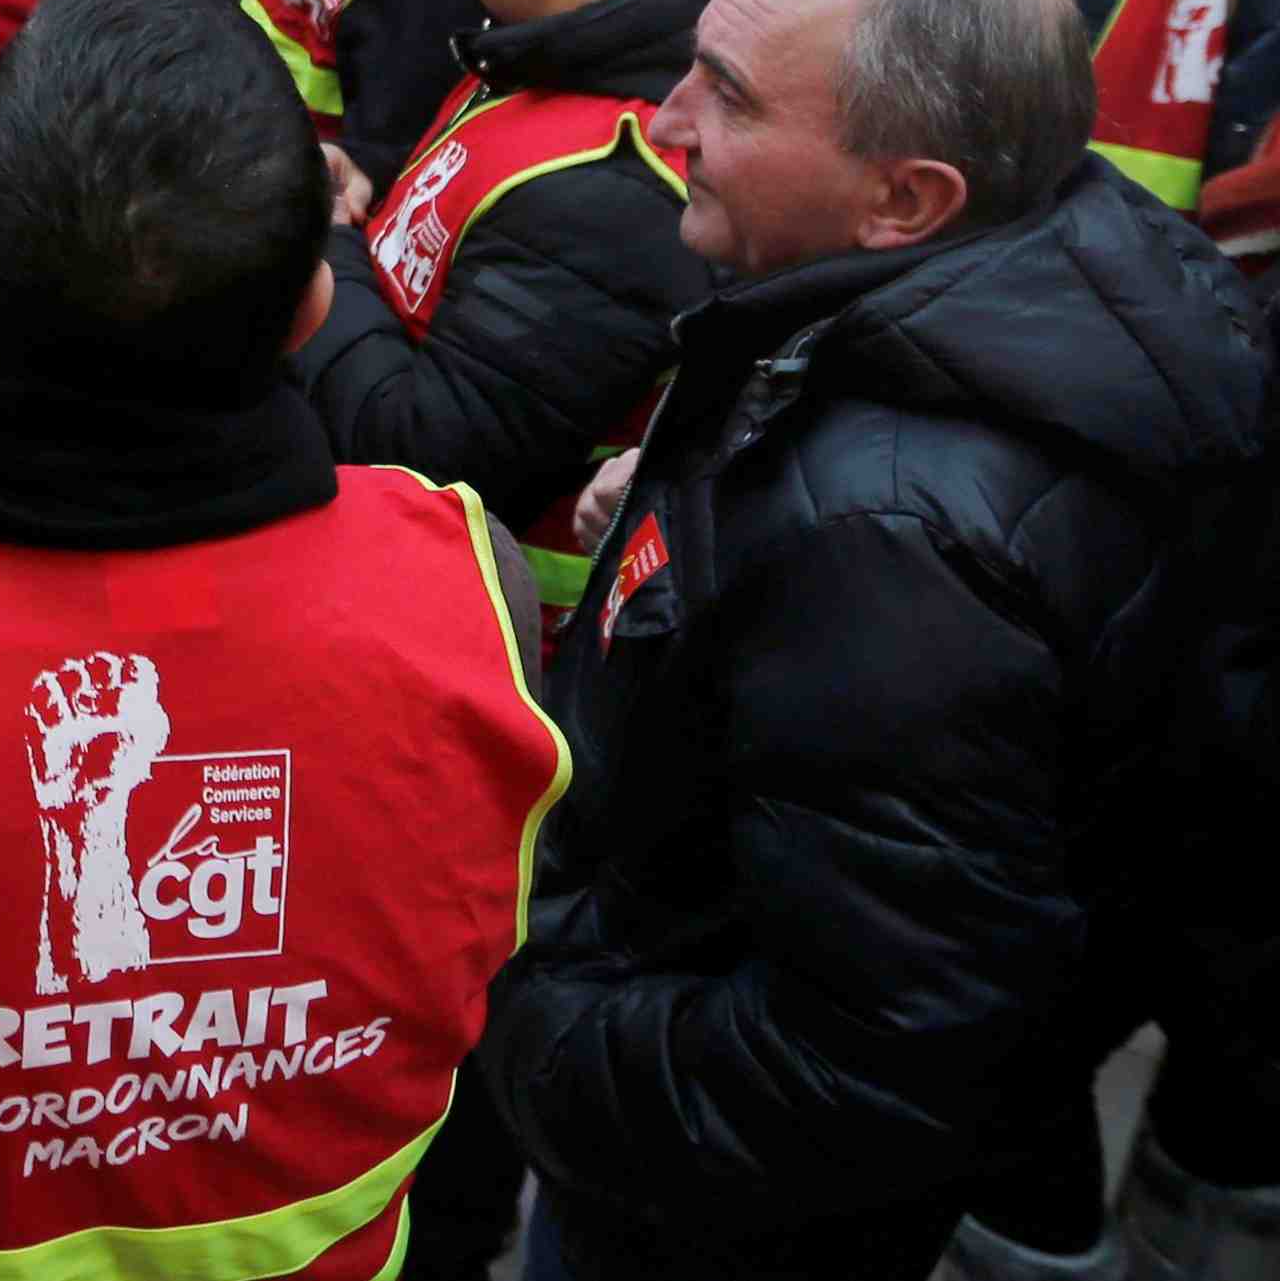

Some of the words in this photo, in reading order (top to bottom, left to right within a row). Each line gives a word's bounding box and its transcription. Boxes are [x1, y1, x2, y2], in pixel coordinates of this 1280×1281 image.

[203, 762, 281, 783] Fédération
[202, 784, 281, 805] Commerce
[209, 805, 273, 824] Services
[138, 835, 283, 939] cgt
[23, 1103, 248, 1178] MACRON
